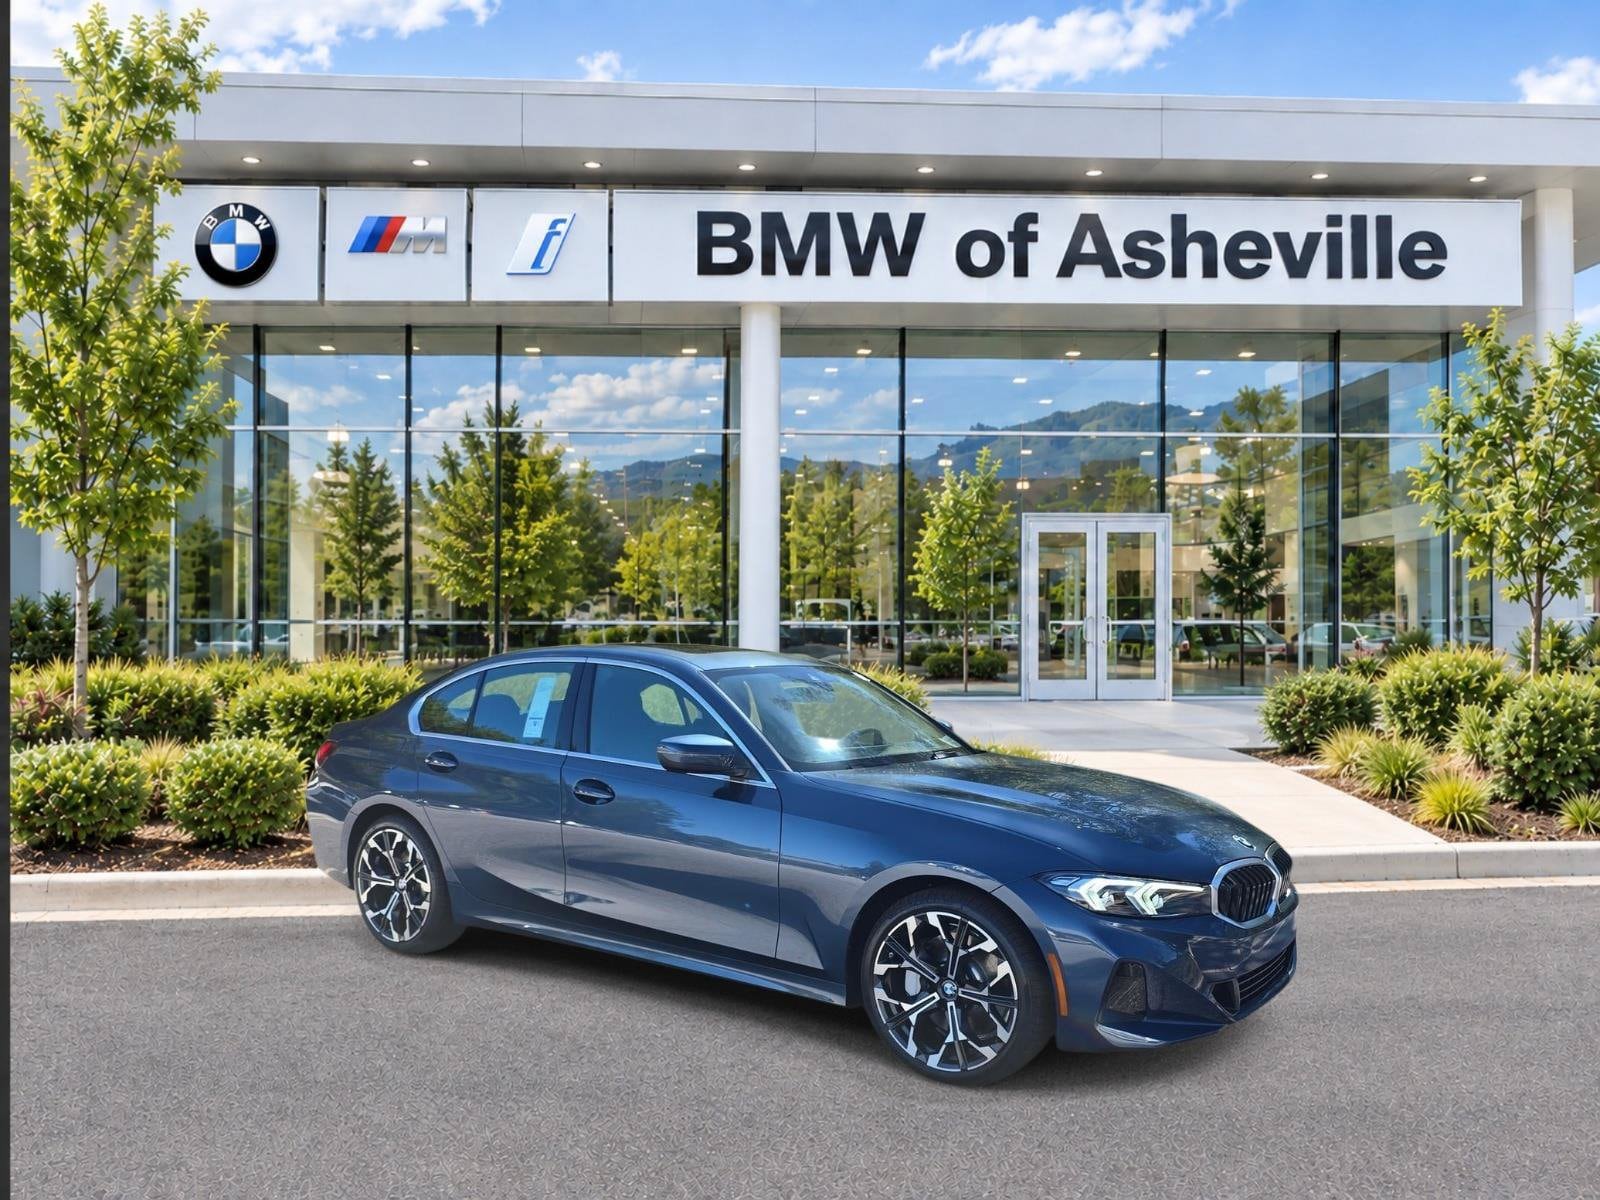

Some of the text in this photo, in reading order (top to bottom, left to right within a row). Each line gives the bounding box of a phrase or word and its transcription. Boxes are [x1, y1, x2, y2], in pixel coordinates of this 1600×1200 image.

[203, 204, 270, 230] BMW
[697, 210, 1448, 280] BMW of Asheville
